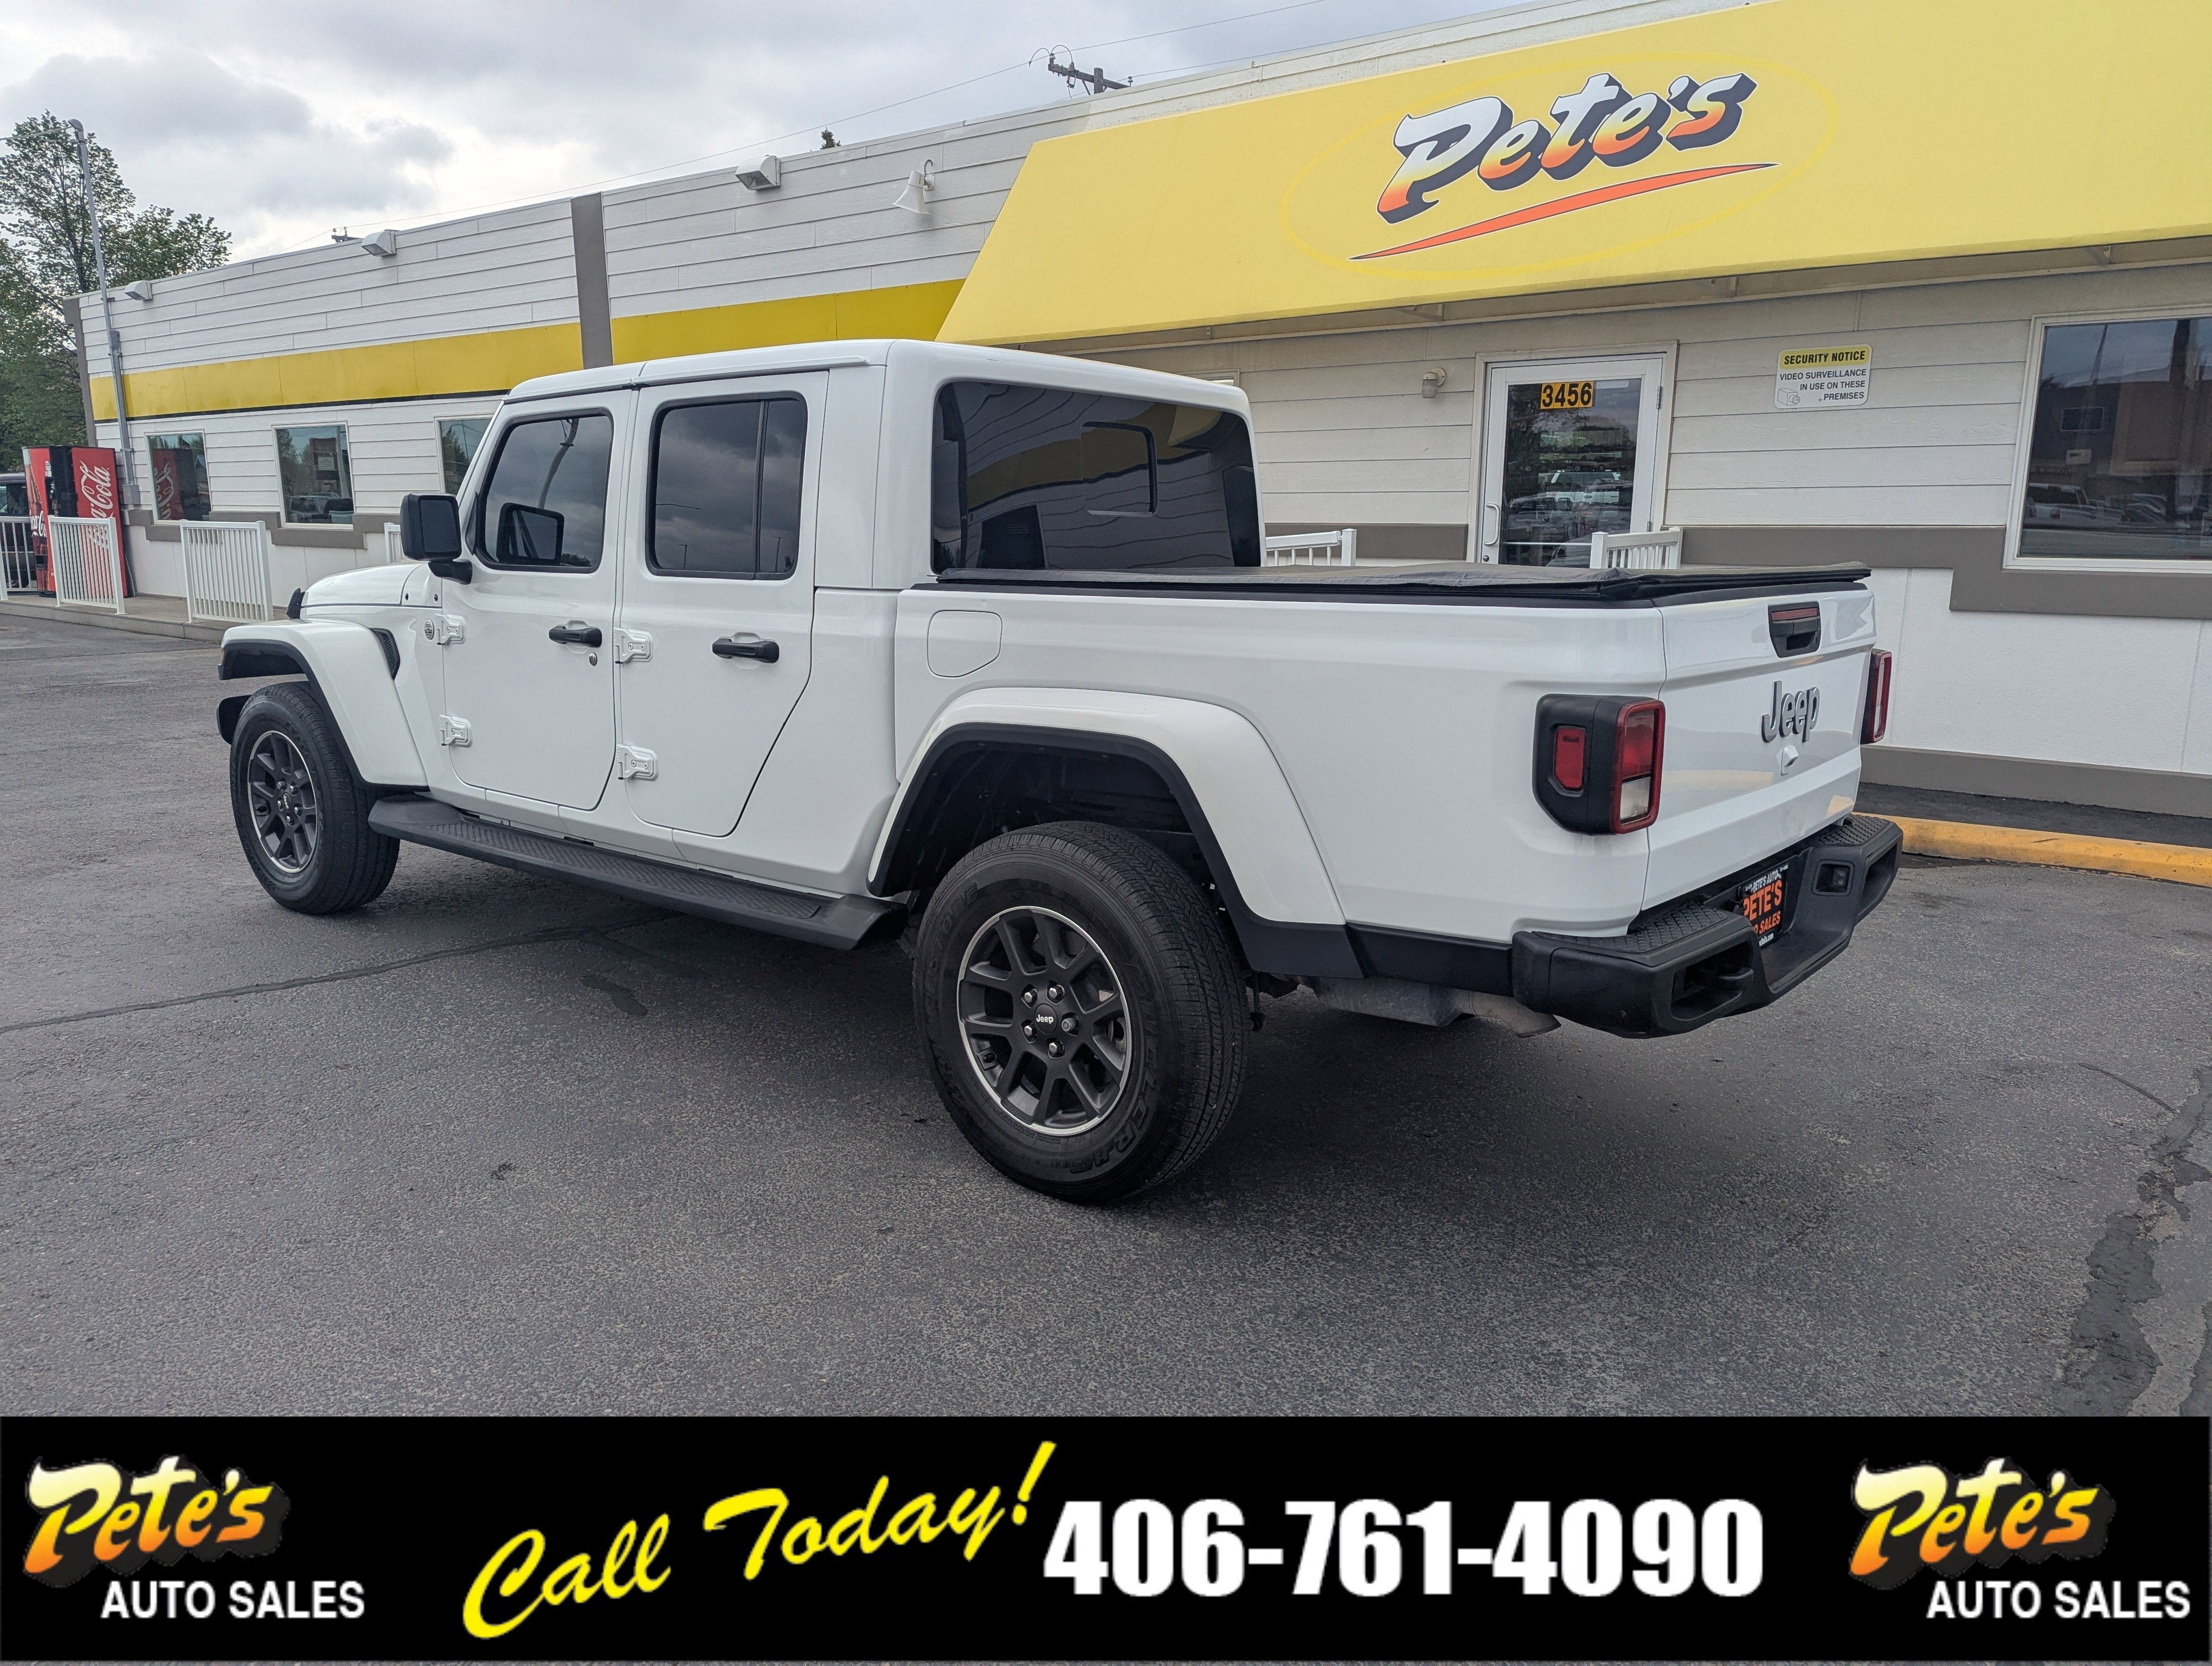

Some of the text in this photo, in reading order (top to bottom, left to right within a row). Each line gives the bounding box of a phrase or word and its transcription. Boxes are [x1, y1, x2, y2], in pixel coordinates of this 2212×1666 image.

[1377, 73, 1758, 223] Pete's
[1784, 350, 1866, 365] SECURITY NOTICE
[1780, 368, 1867, 381] VIDEO SURVEILLANCE
[1809, 382, 1825, 390] USE
[1840, 380, 1866, 388] THESE
[1542, 382, 1593, 408] 3456
[1823, 392, 1864, 401] PREMISES
[1761, 681, 1820, 743] Jeep
[1743, 880, 1782, 921] PETE'S
[1759, 911, 1781, 934] SALES
[1036, 1014, 1054, 1024] Jeep
